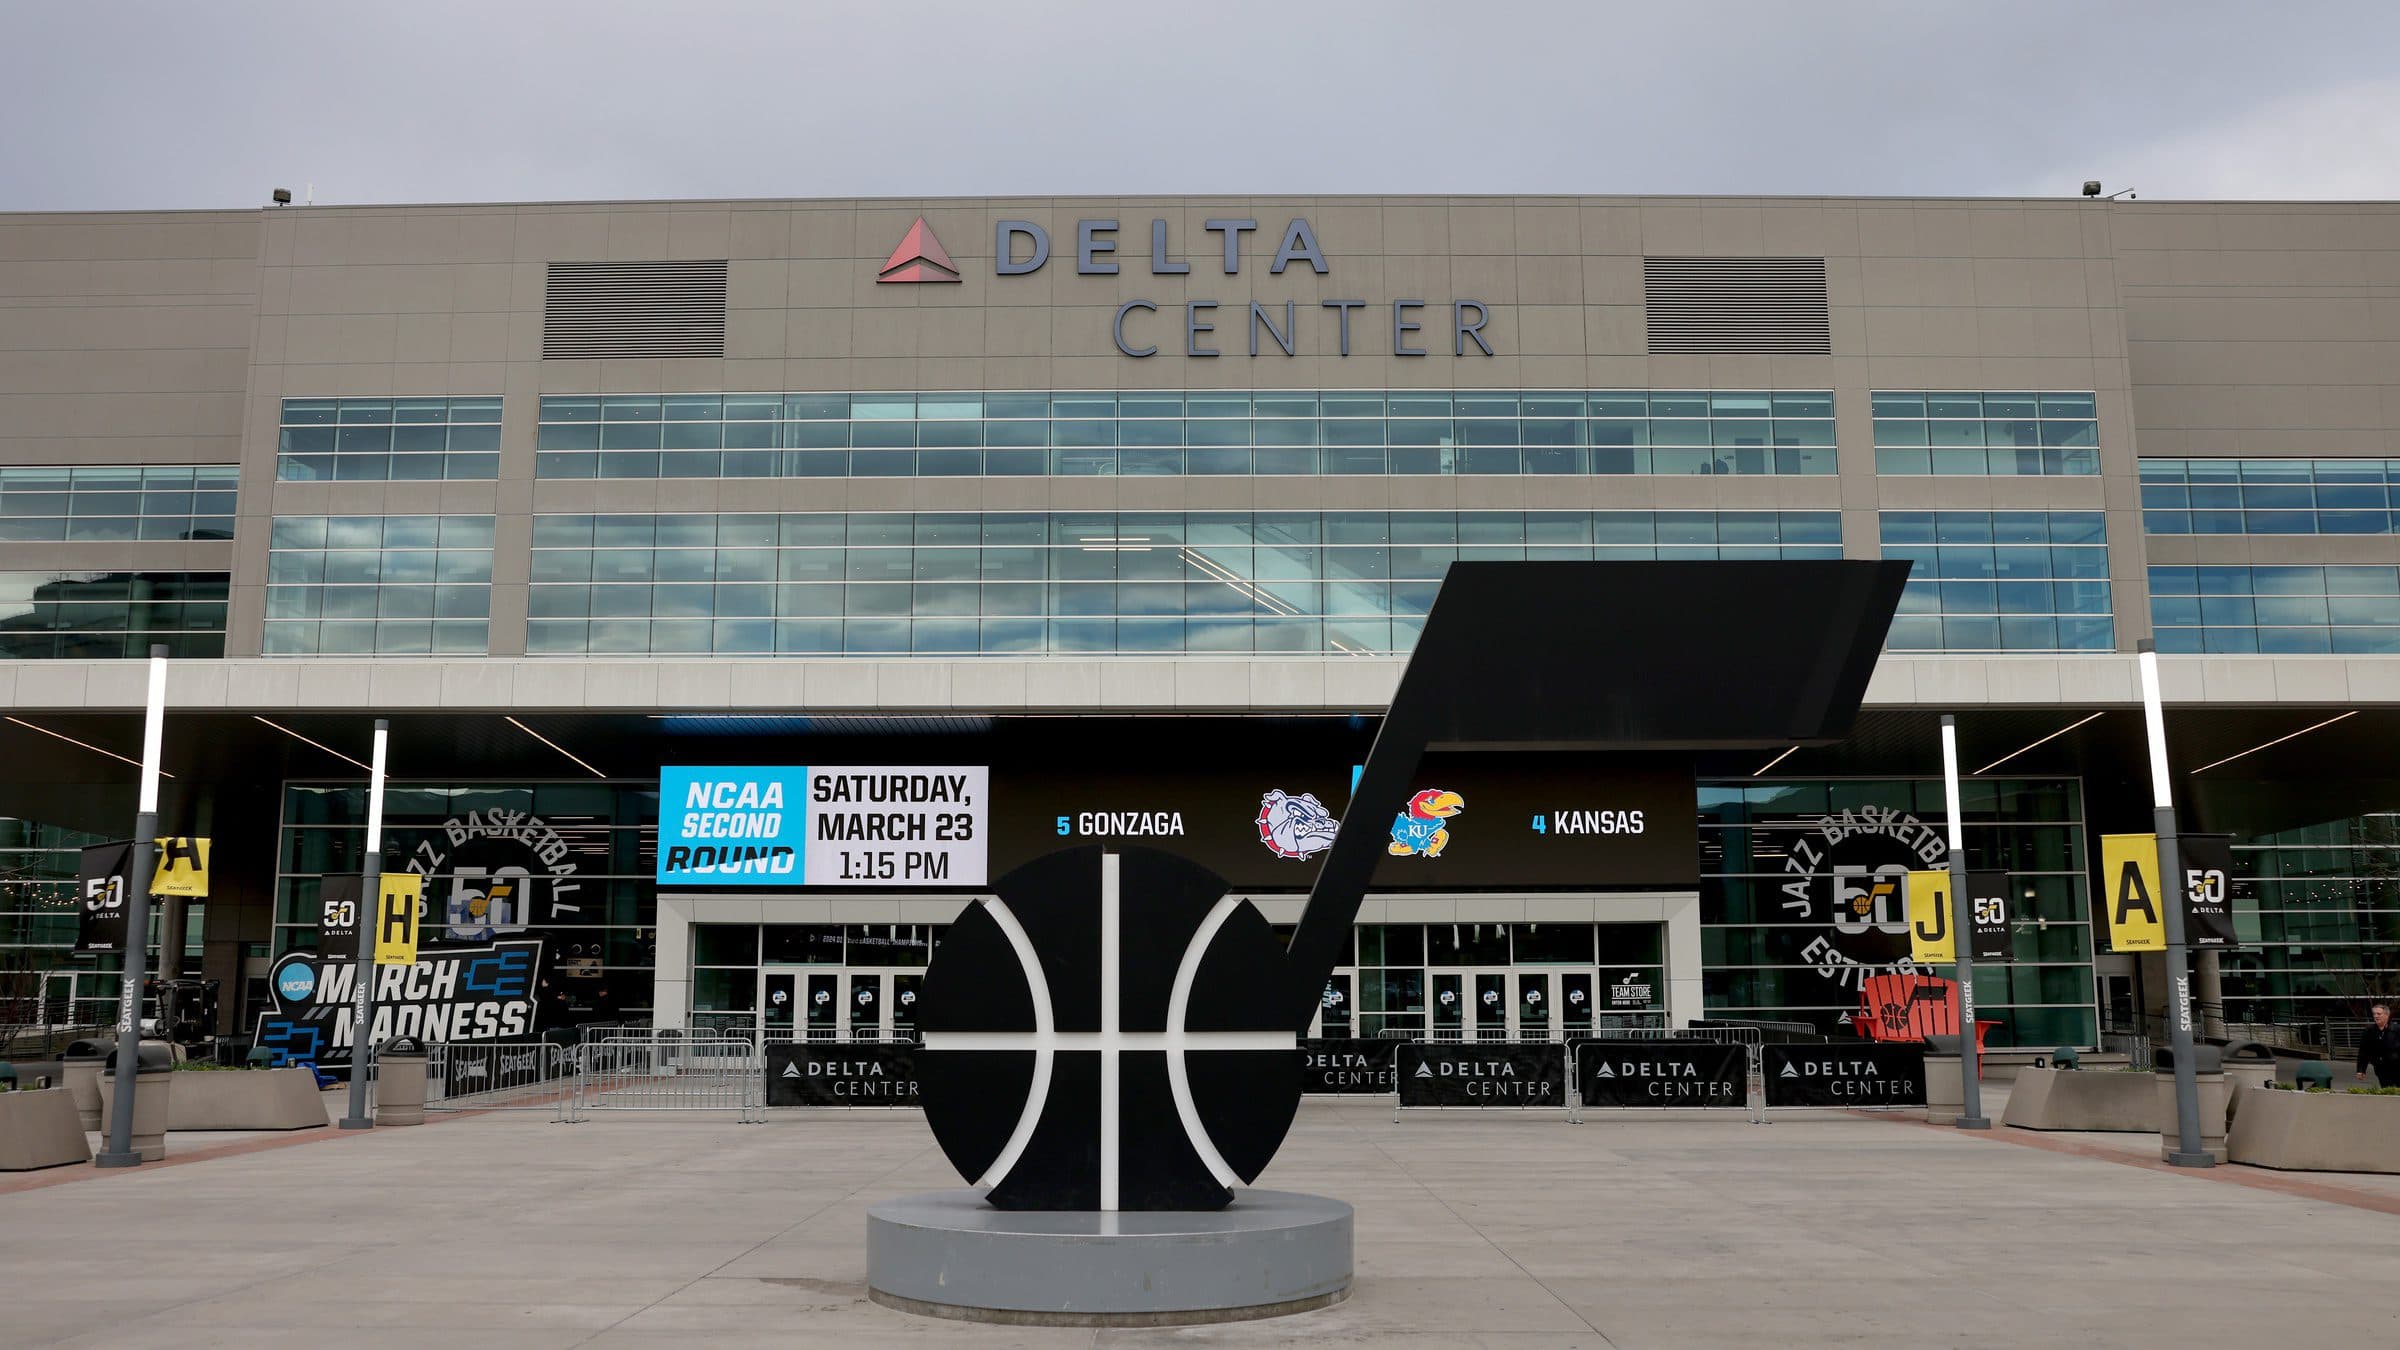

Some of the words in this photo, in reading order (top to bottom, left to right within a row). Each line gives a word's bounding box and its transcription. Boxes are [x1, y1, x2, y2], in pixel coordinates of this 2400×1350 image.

[996, 218, 1328, 275] DELTA
[1113, 299, 1494, 358] CENTER
[685, 782, 783, 809] NCAA
[813, 775, 970, 807] SATURDAY,
[681, 812, 782, 839] SECOND
[817, 813, 926, 841] MARCH
[935, 813, 973, 841] 23
[1056, 816, 1071, 836] 5
[1078, 812, 1185, 836] GONZAGA
[1408, 824, 1428, 838] KU
[1531, 815, 1547, 834] 4
[1554, 810, 1645, 834] KANSAS
[1817, 805, 1950, 871] BASKETB
[443, 807, 581, 918] BASKETBALL
[665, 846, 795, 874] ROUND
[839, 851, 895, 880] 1:15
[905, 851, 949, 880] PM
[1782, 838, 1824, 918] JAZZ
[2187, 870, 2225, 903] 50
[87, 875, 124, 911] 50
[449, 866, 531, 936] 50
[1833, 864, 1910, 934] 50
[2115, 861, 2158, 925] A
[324, 900, 355, 927] 50
[383, 894, 413, 944] H
[1916, 892, 1946, 942] J
[1974, 898, 2006, 924] 50
[282, 981, 314, 992] NCAA
[1611, 986, 1630, 998] TEAM
[1630, 986, 1652, 998] STORE
[121, 978, 136, 1033] SEATGEEK
[355, 982, 366, 1025] SEATGEEK
[1962, 980, 1975, 1024] SEATGEEK
[2176, 976, 2192, 1032] SEATGEEK
[332, 1001, 528, 1047] MADNESS
[500, 1050, 537, 1076] SEATGEEK
[808, 1061, 884, 1076] DELTA
[1440, 1062, 1515, 1076] DELTA
[1622, 1062, 1697, 1077] DELTA
[1805, 1061, 1878, 1076] DELTA
[834, 1081, 919, 1096] CENTER
[1324, 1071, 1399, 1085] CENTER
[1466, 1081, 1550, 1096] CENTER
[1648, 1081, 1734, 1096] CENTER
[1831, 1080, 1914, 1096] CENTER
